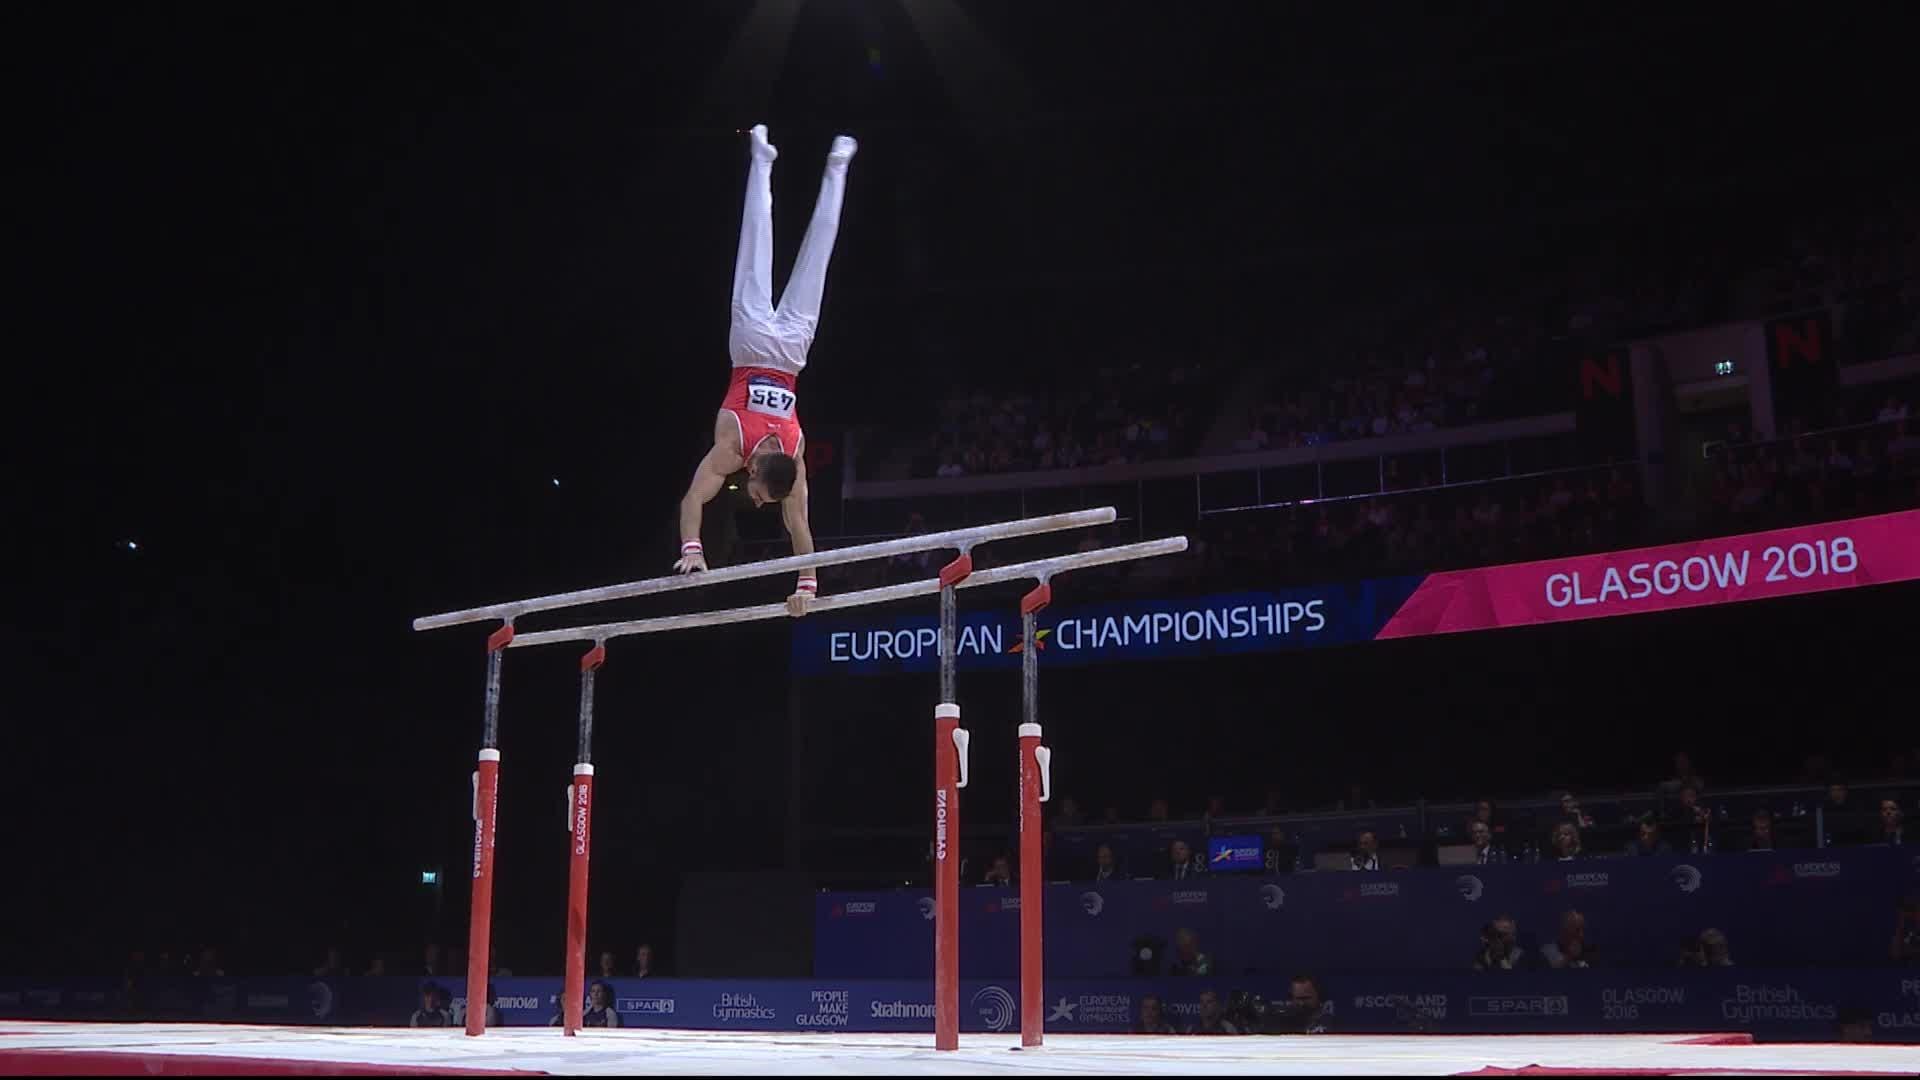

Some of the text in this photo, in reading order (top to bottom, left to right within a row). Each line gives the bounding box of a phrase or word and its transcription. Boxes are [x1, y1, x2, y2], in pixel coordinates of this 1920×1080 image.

[1776, 319, 1823, 367] N
[1581, 354, 1621, 399] N
[752, 389, 793, 410] 435
[1545, 537, 1859, 608] GLASGOW 2018
[1056, 599, 1325, 650] CHAMPIONSHIPS
[721, 992, 756, 1008] British
[811, 990, 849, 1002] PEOPLE
[1079, 995, 1130, 1007] EUROPEAN
[1602, 987, 1685, 1004] GLASGOW
[1736, 984, 1798, 1003] British
[625, 1001, 659, 1011] SPAR
[713, 1005, 776, 1021] Gymnastics
[819, 1003, 849, 1014] MAKE
[871, 1000, 936, 1018] Strathmor
[1487, 1000, 1544, 1012] SPAR
[1721, 999, 1836, 1023] Gymnastics
[796, 1014, 849, 1026] GLASGOW
